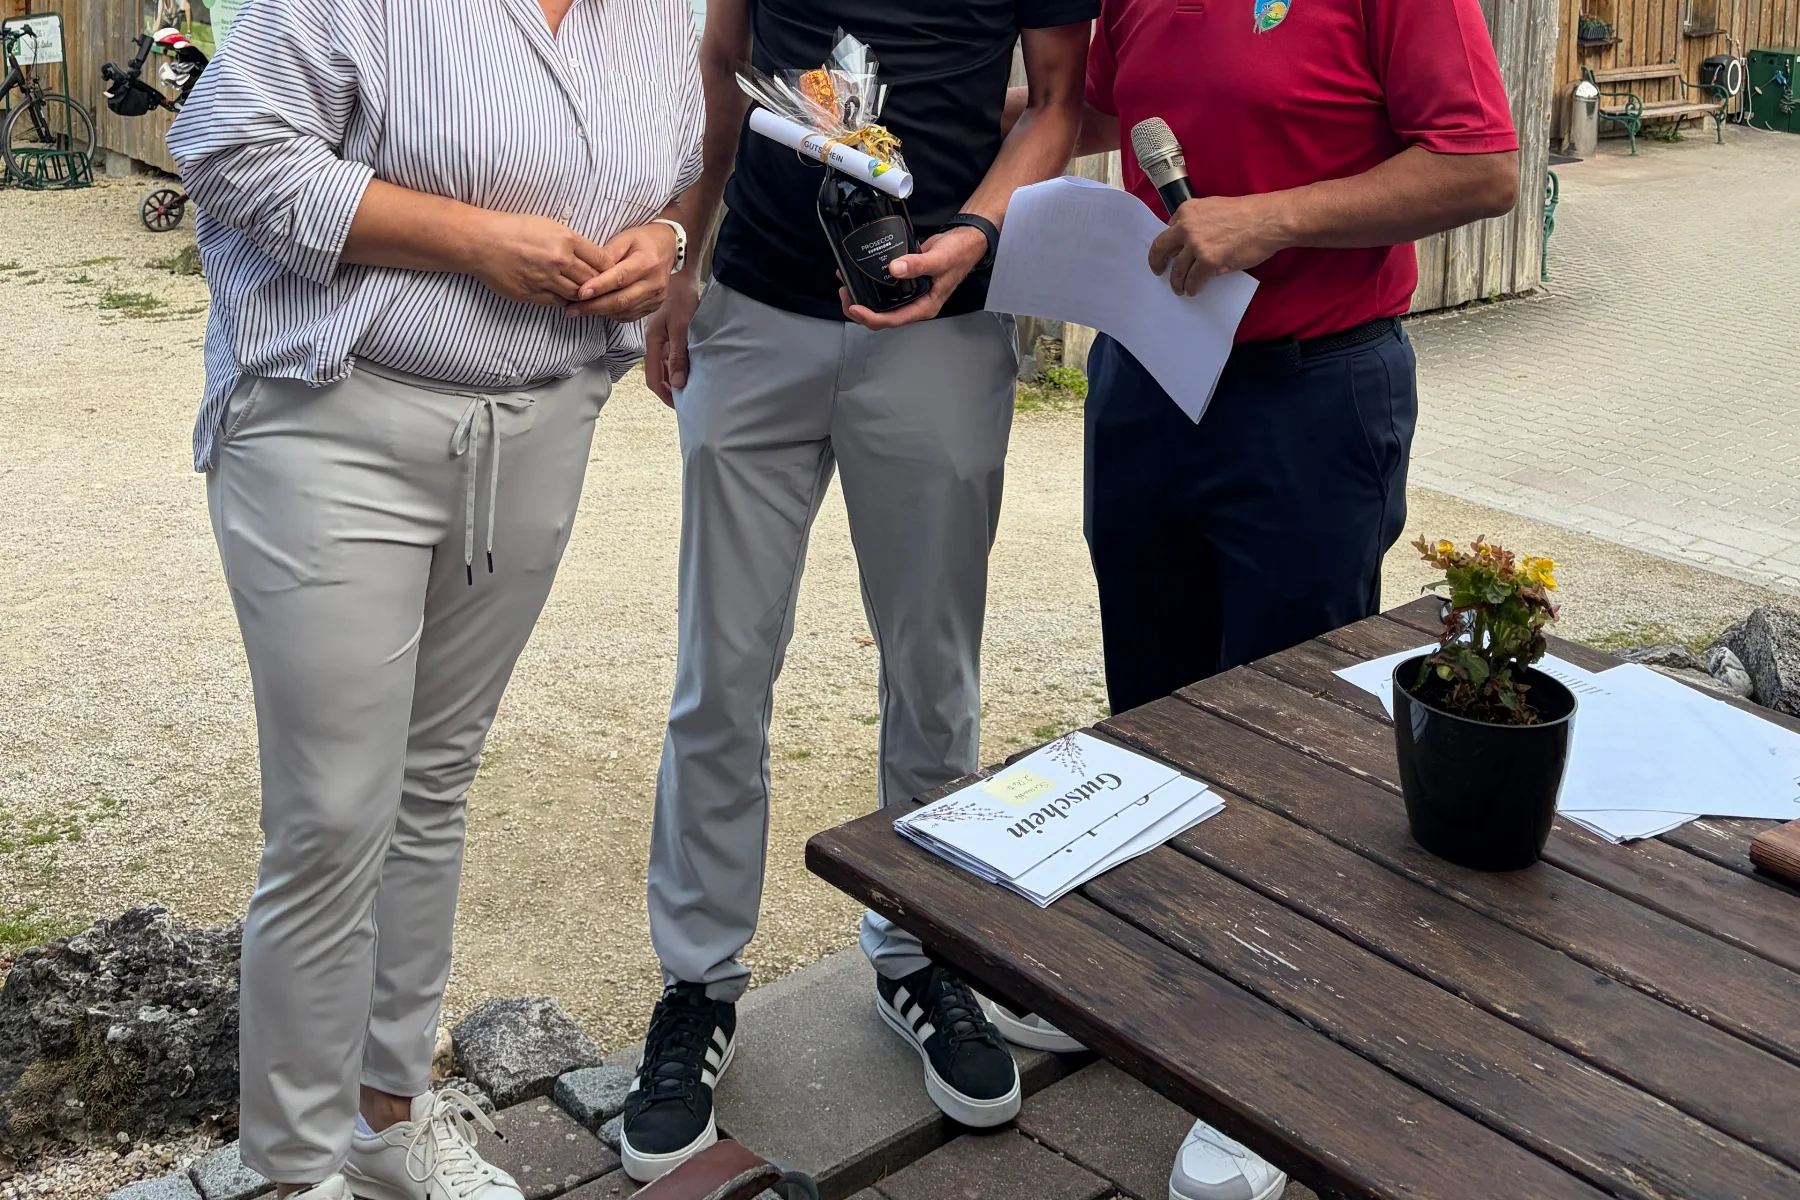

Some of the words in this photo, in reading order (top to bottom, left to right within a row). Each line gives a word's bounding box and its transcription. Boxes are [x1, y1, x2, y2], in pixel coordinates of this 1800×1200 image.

[803, 140, 844, 163] GUTSHEIN
[861, 234, 894, 251] PROSECCO
[1006, 773, 1122, 838] Gutschein
